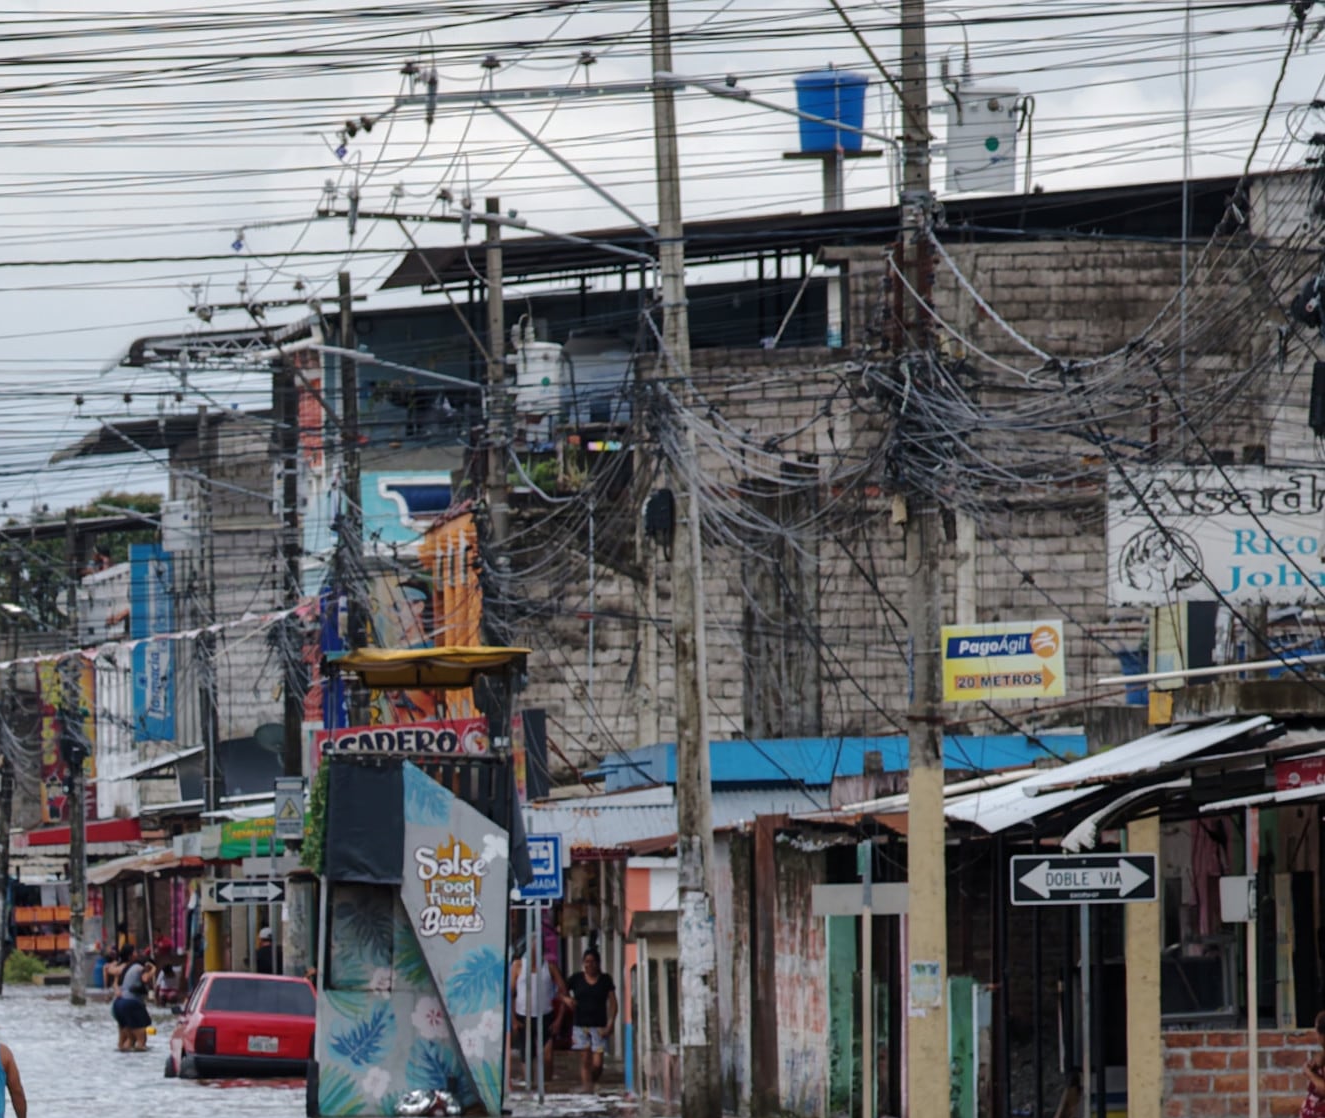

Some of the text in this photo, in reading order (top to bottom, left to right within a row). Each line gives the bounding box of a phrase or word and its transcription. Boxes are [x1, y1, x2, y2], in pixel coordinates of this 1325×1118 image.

[959, 635, 1027, 655] PagoÁgil
[958, 673, 1042, 688] 20 METROS
[415, 843, 487, 880] Salse
[1045, 871, 1123, 886] DOBLE VIA
[430, 879, 475, 895] Food
